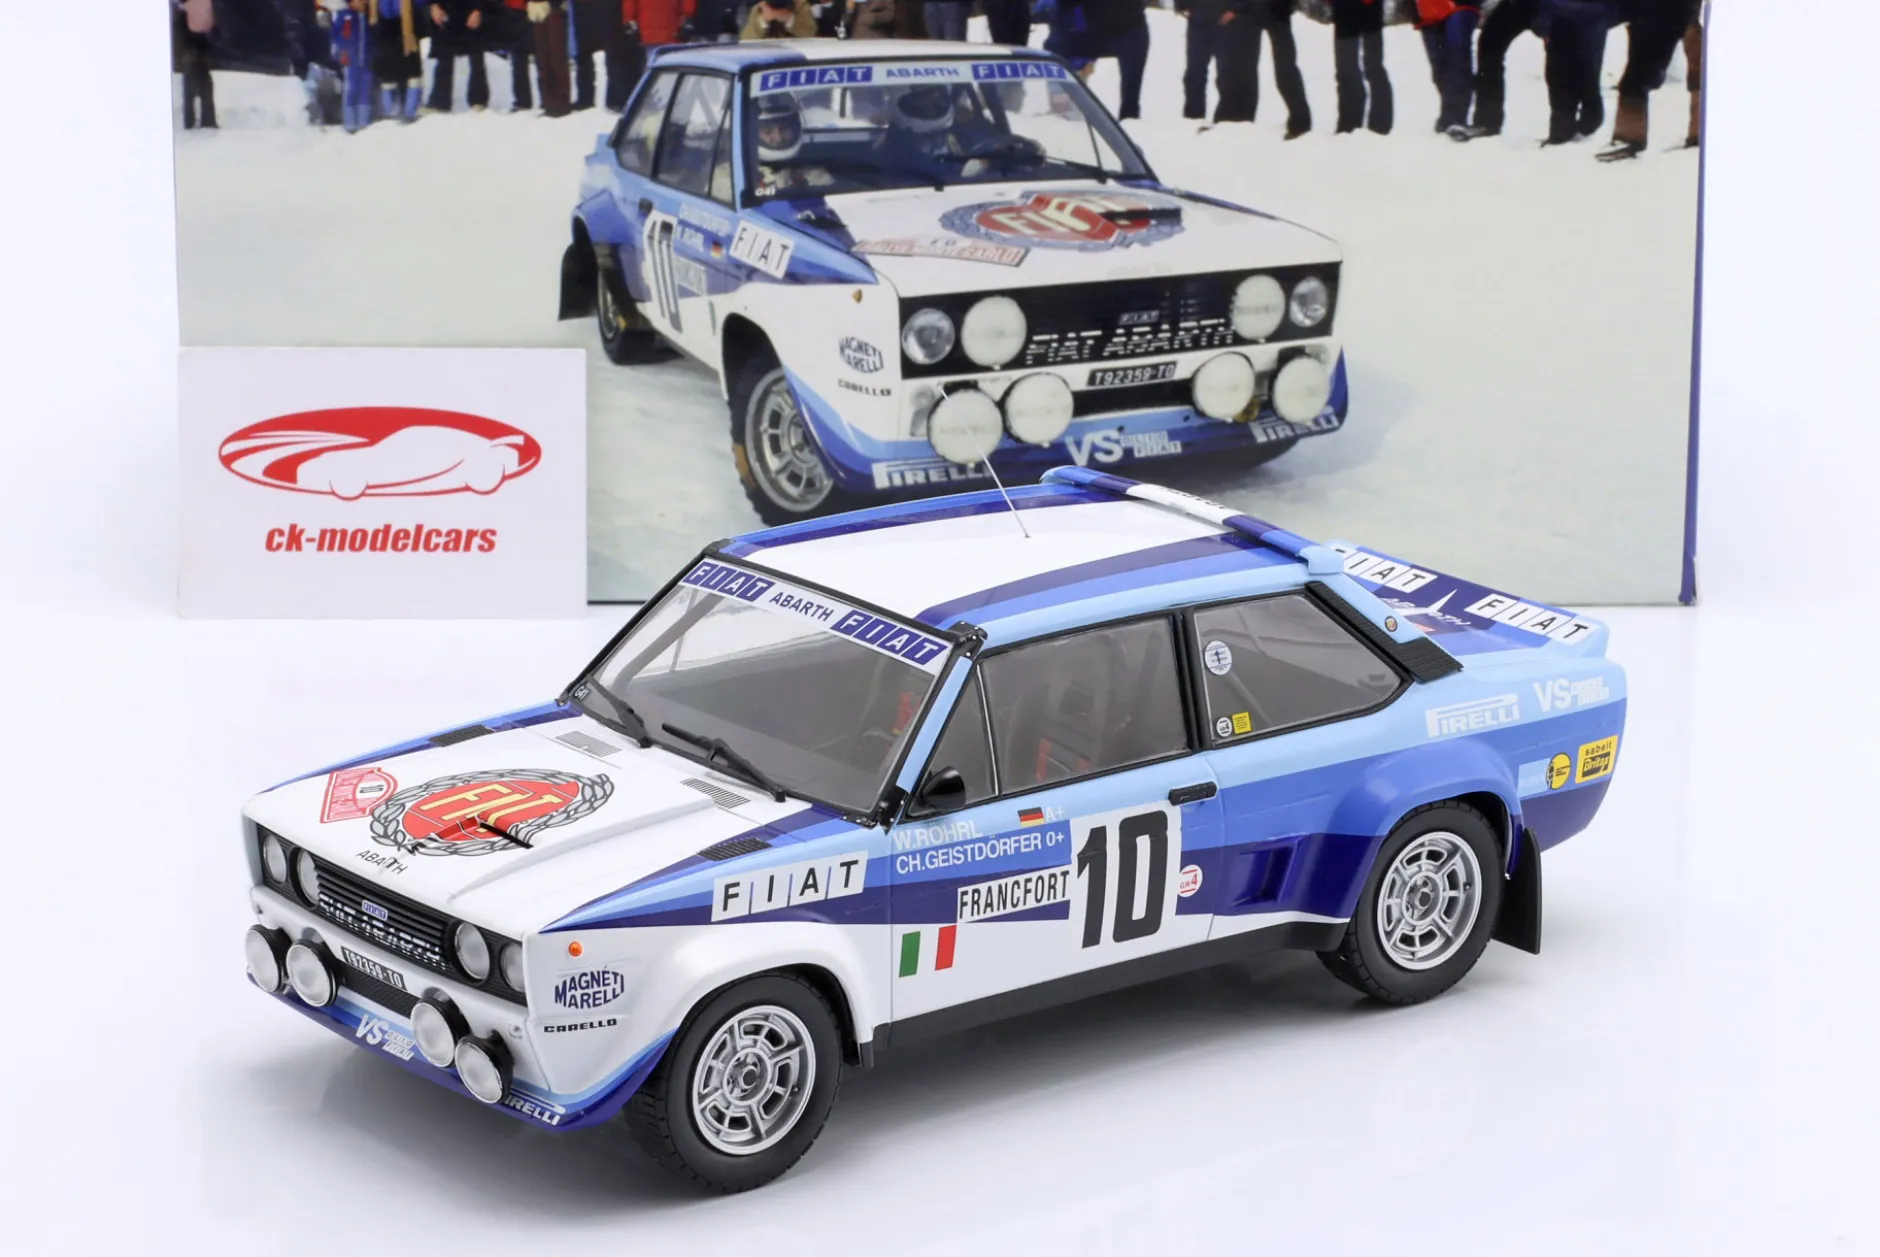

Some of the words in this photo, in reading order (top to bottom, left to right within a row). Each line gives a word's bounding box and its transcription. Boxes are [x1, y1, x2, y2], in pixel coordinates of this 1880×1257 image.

[764, 64, 870, 90] FIAT
[886, 66, 960, 79] ABARTH
[974, 62, 1064, 79] FIAT
[733, 227, 790, 272] FIAT
[648, 219, 683, 333] 10
[1065, 429, 1124, 467] VS
[265, 523, 497, 553] ck-modelcars
[686, 562, 770, 600] FIAT
[769, 591, 834, 622] ABARTH
[836, 612, 943, 662] FIAT
[1476, 598, 1589, 639] FIAT
[1425, 691, 1521, 738] PIRELLI
[1533, 677, 1571, 713] VS
[1584, 740, 1613, 757] sabelt
[896, 830, 1043, 875] CH.GEISTDÖRFER
[722, 859, 860, 913] FIAT
[959, 870, 1071, 920] FRANCFORT
[1077, 810, 1168, 949] 10
[355, 1014, 389, 1045] VS
[543, 1018, 618, 1034] CARELLO
